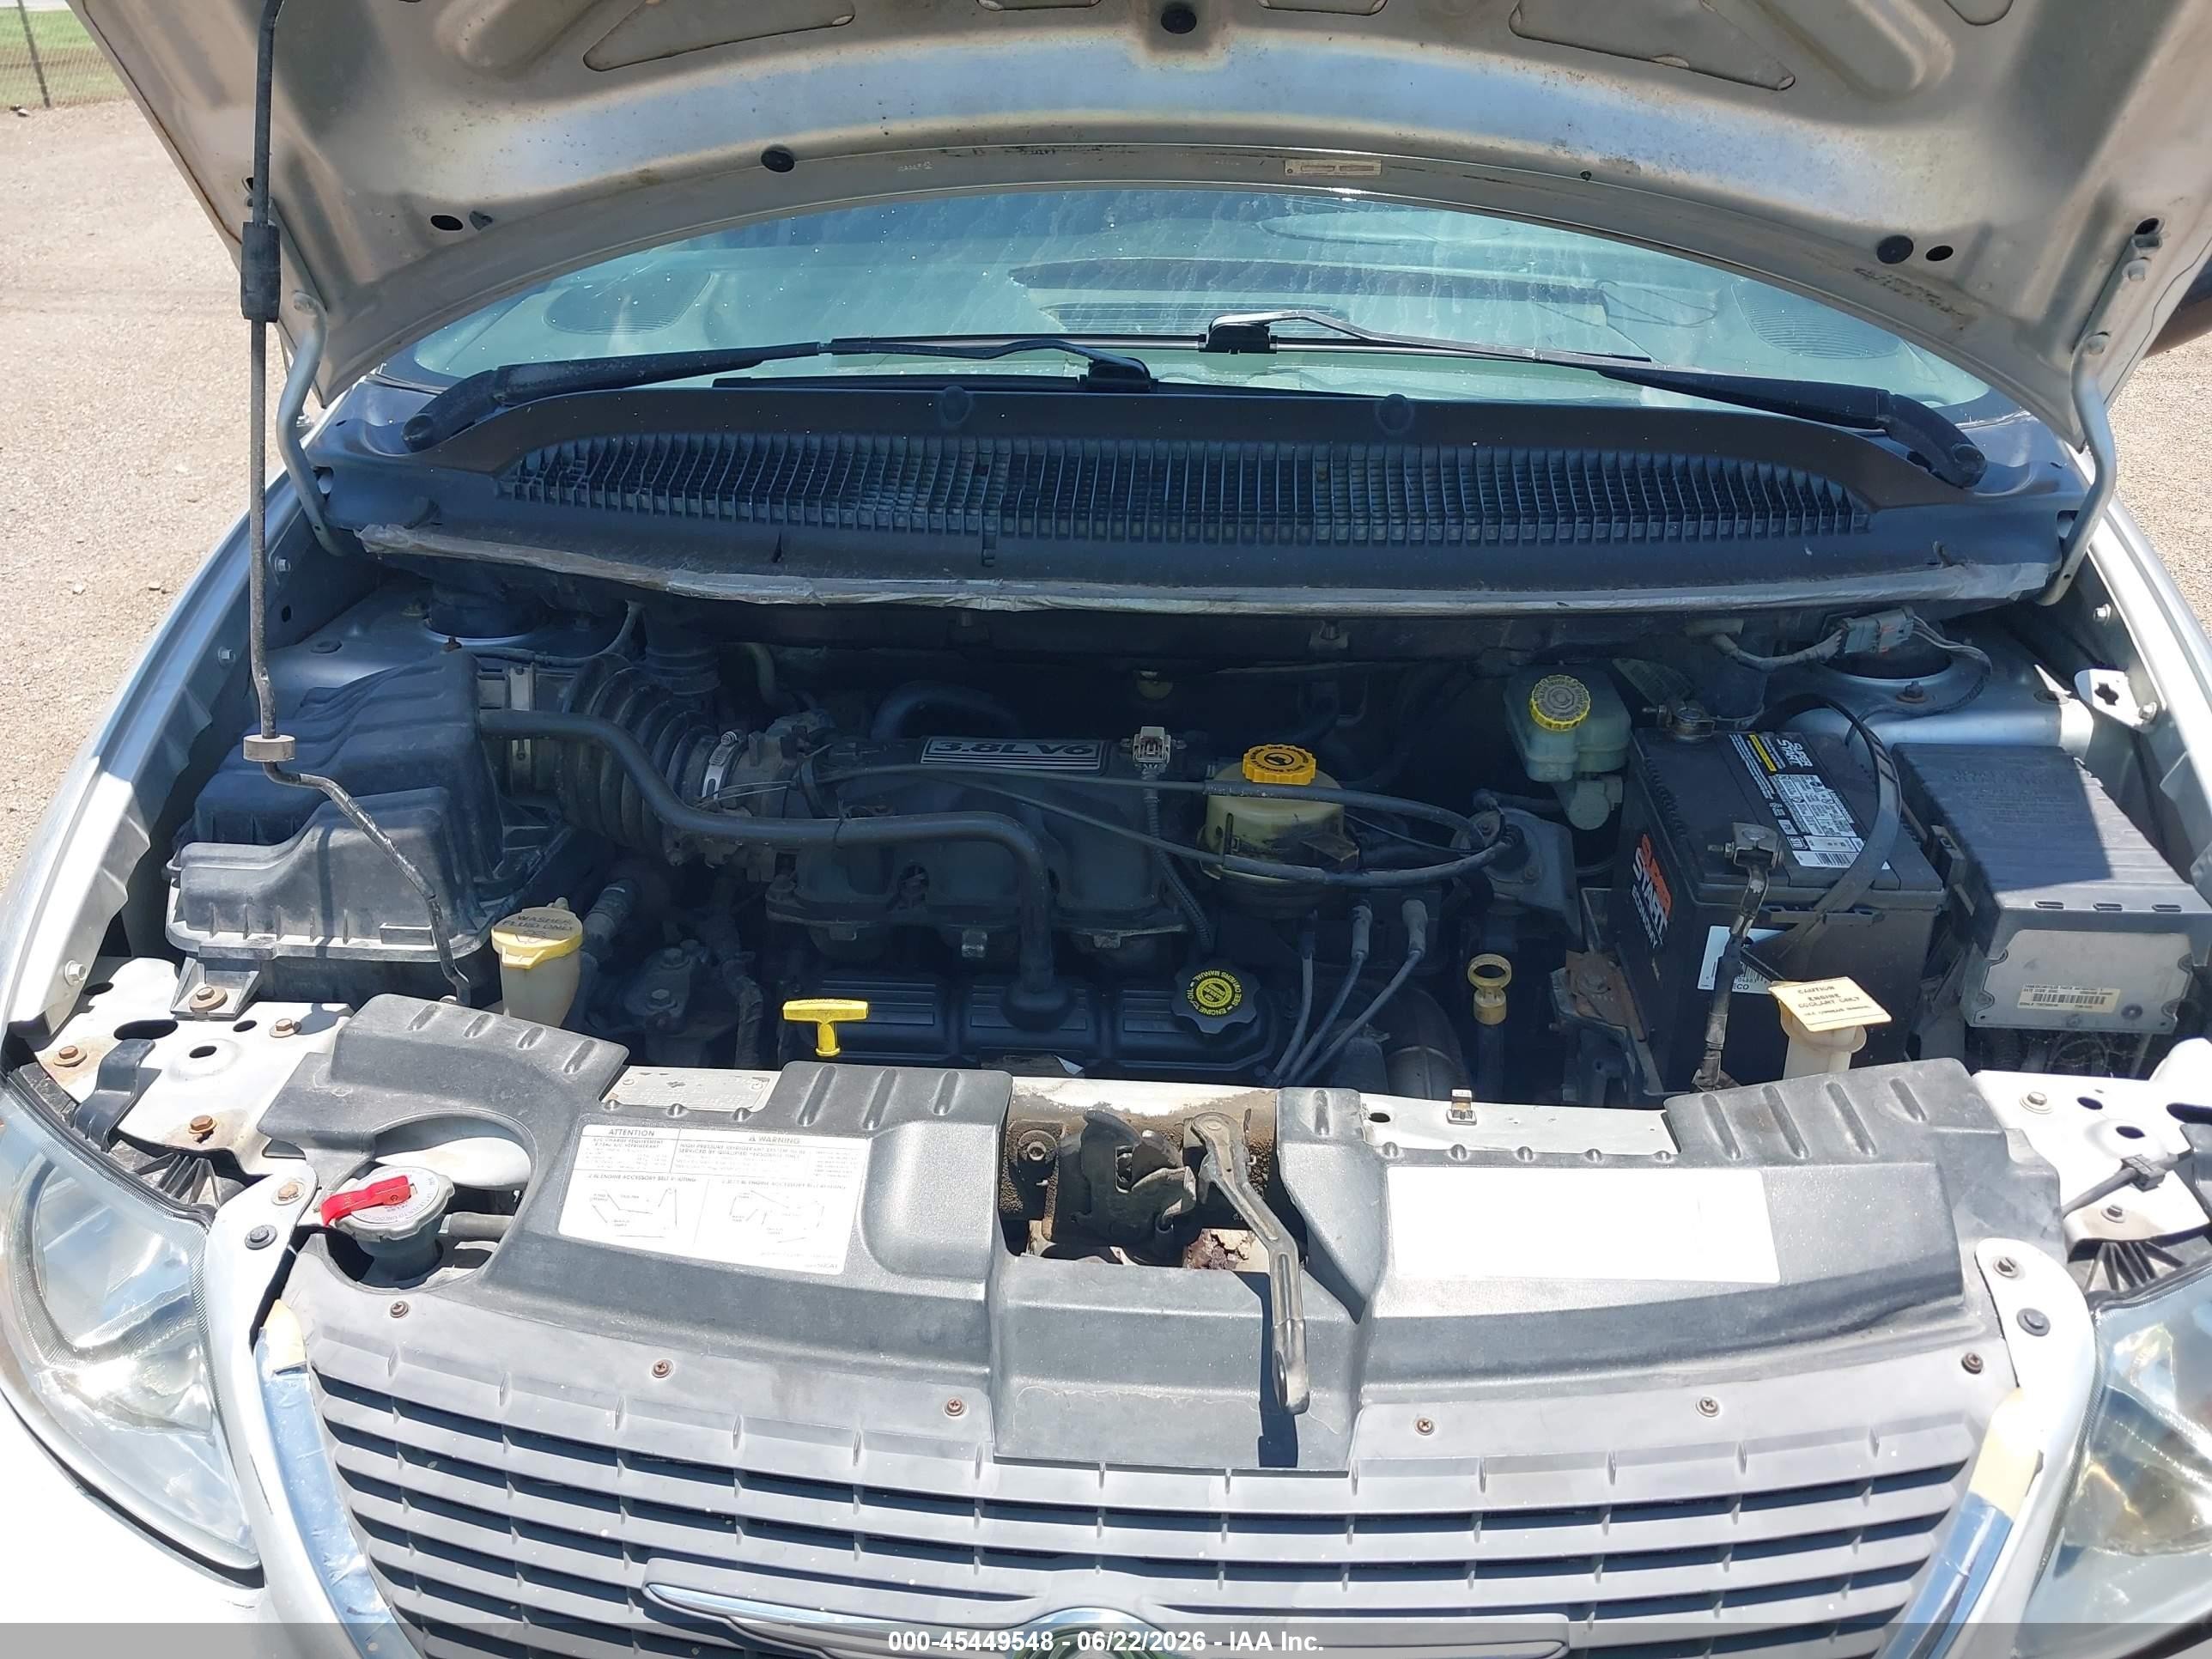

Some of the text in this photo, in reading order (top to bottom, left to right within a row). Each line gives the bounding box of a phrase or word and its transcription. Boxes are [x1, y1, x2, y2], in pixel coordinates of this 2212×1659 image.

[933, 742, 1093, 755] 3.8L V6
[1632, 846, 1668, 931] START
[502, 920, 538, 928] FLUID
[518, 915, 573, 924] WASHER
[1192, 969, 1220, 981] MANUAL
[1797, 986, 1836, 994] CAUTION
[1186, 989, 1228, 1016] ENGINE OIL
[1231, 994, 1243, 1006] SEE
[757, 1135, 801, 1145] WARNING
